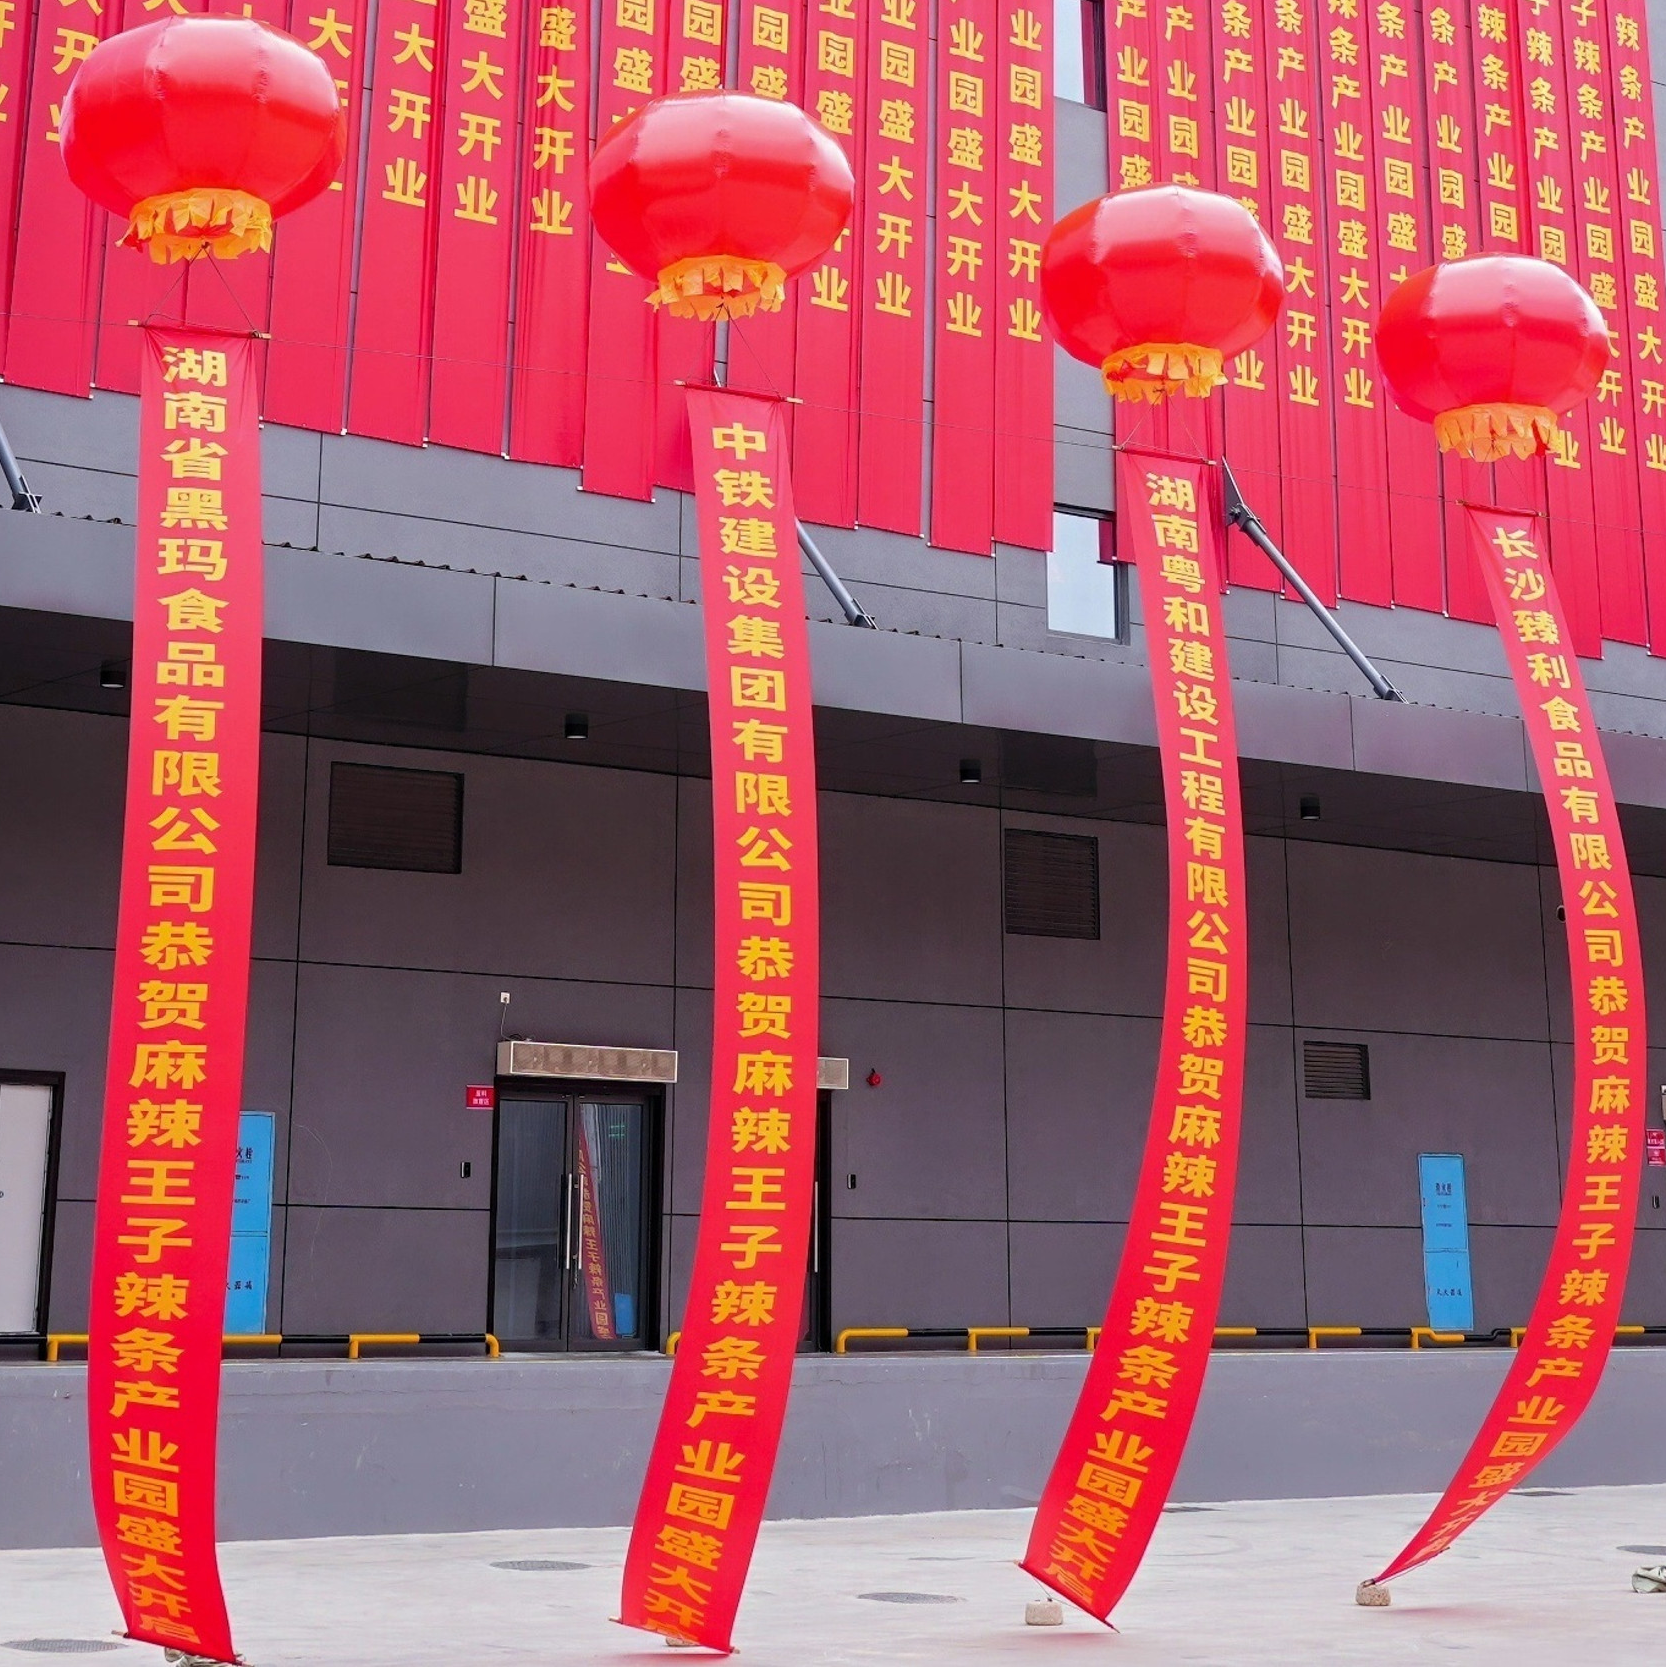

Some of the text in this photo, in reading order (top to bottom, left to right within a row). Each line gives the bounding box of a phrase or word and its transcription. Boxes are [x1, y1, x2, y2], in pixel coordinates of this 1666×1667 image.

[109, 345, 229, 1645] 湖南省黑玛食品有限公司恭贺麻辣王子辣条产业园盛大开启
